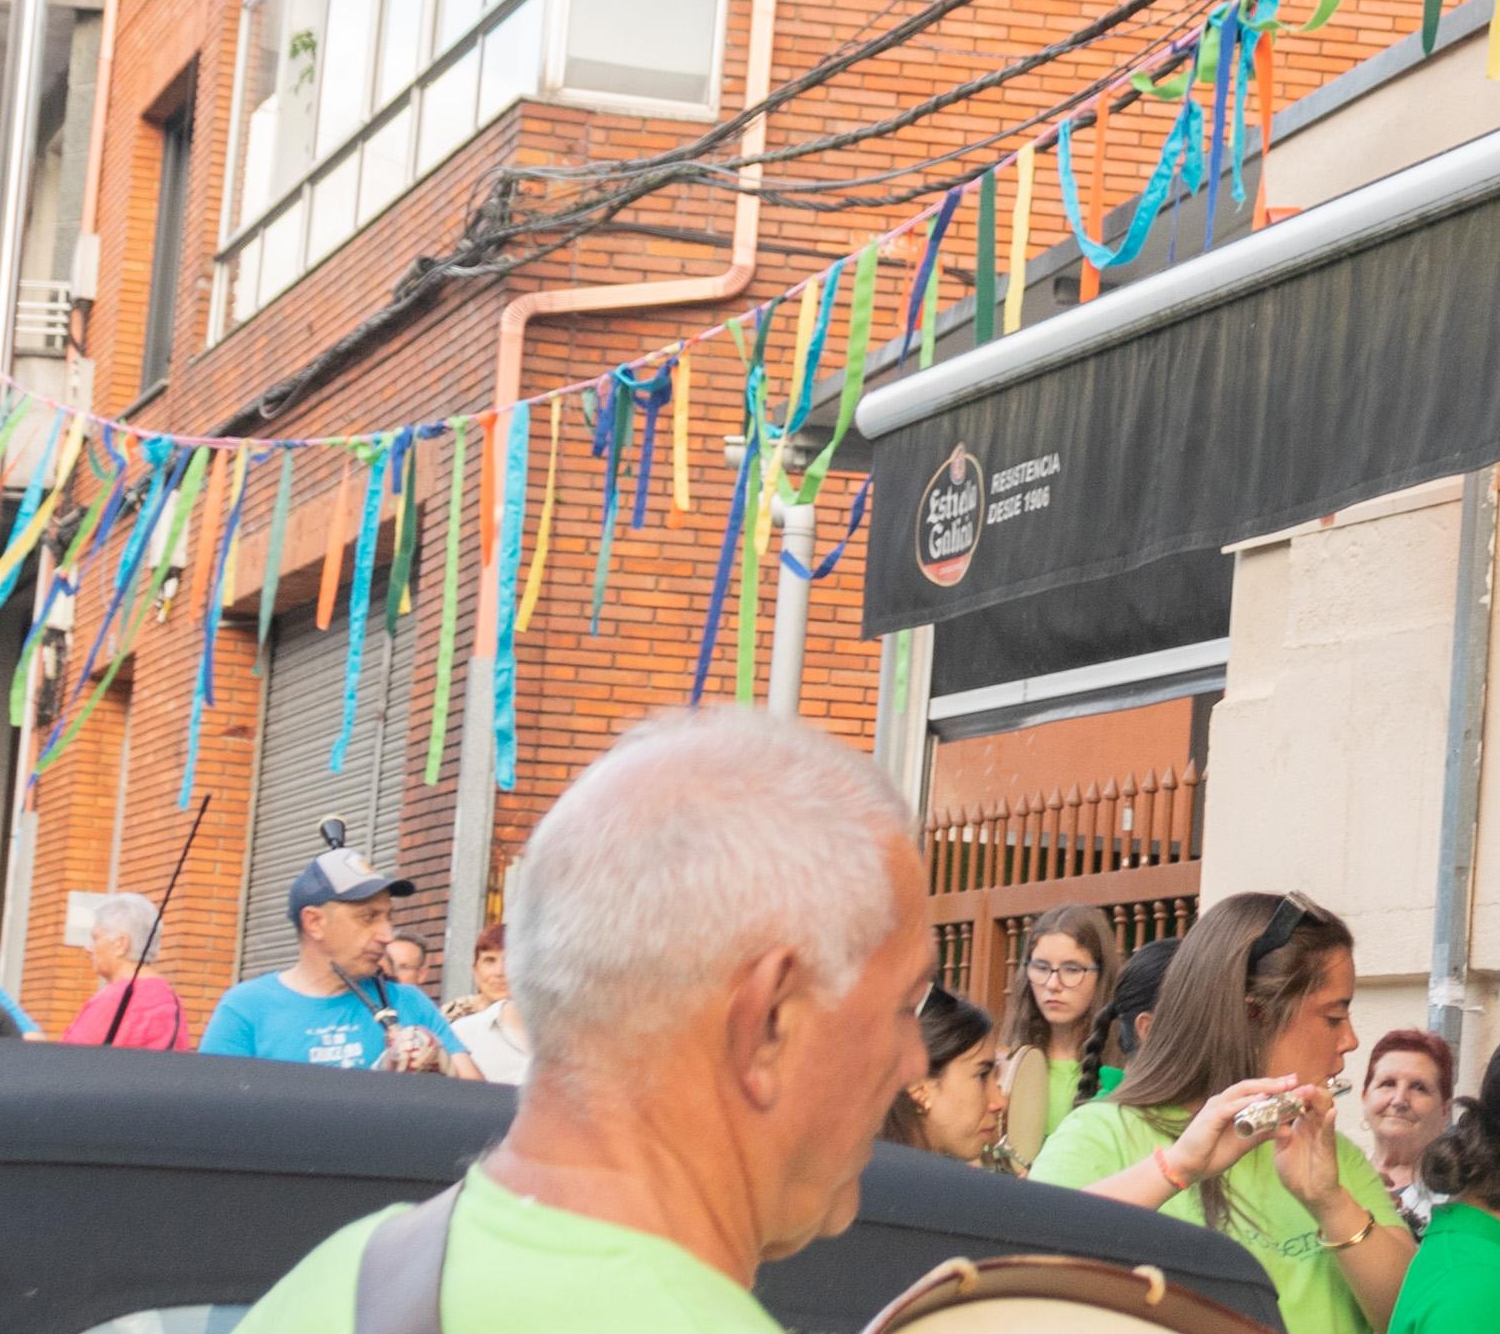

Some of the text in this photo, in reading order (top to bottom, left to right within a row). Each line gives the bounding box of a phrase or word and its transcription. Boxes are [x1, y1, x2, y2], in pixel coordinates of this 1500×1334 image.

[991, 451, 1061, 494] RESISTENCIA
[927, 479, 977, 524] Estrella
[987, 485, 1050, 525] DESDE 1906
[929, 516, 973, 559] Galicia
